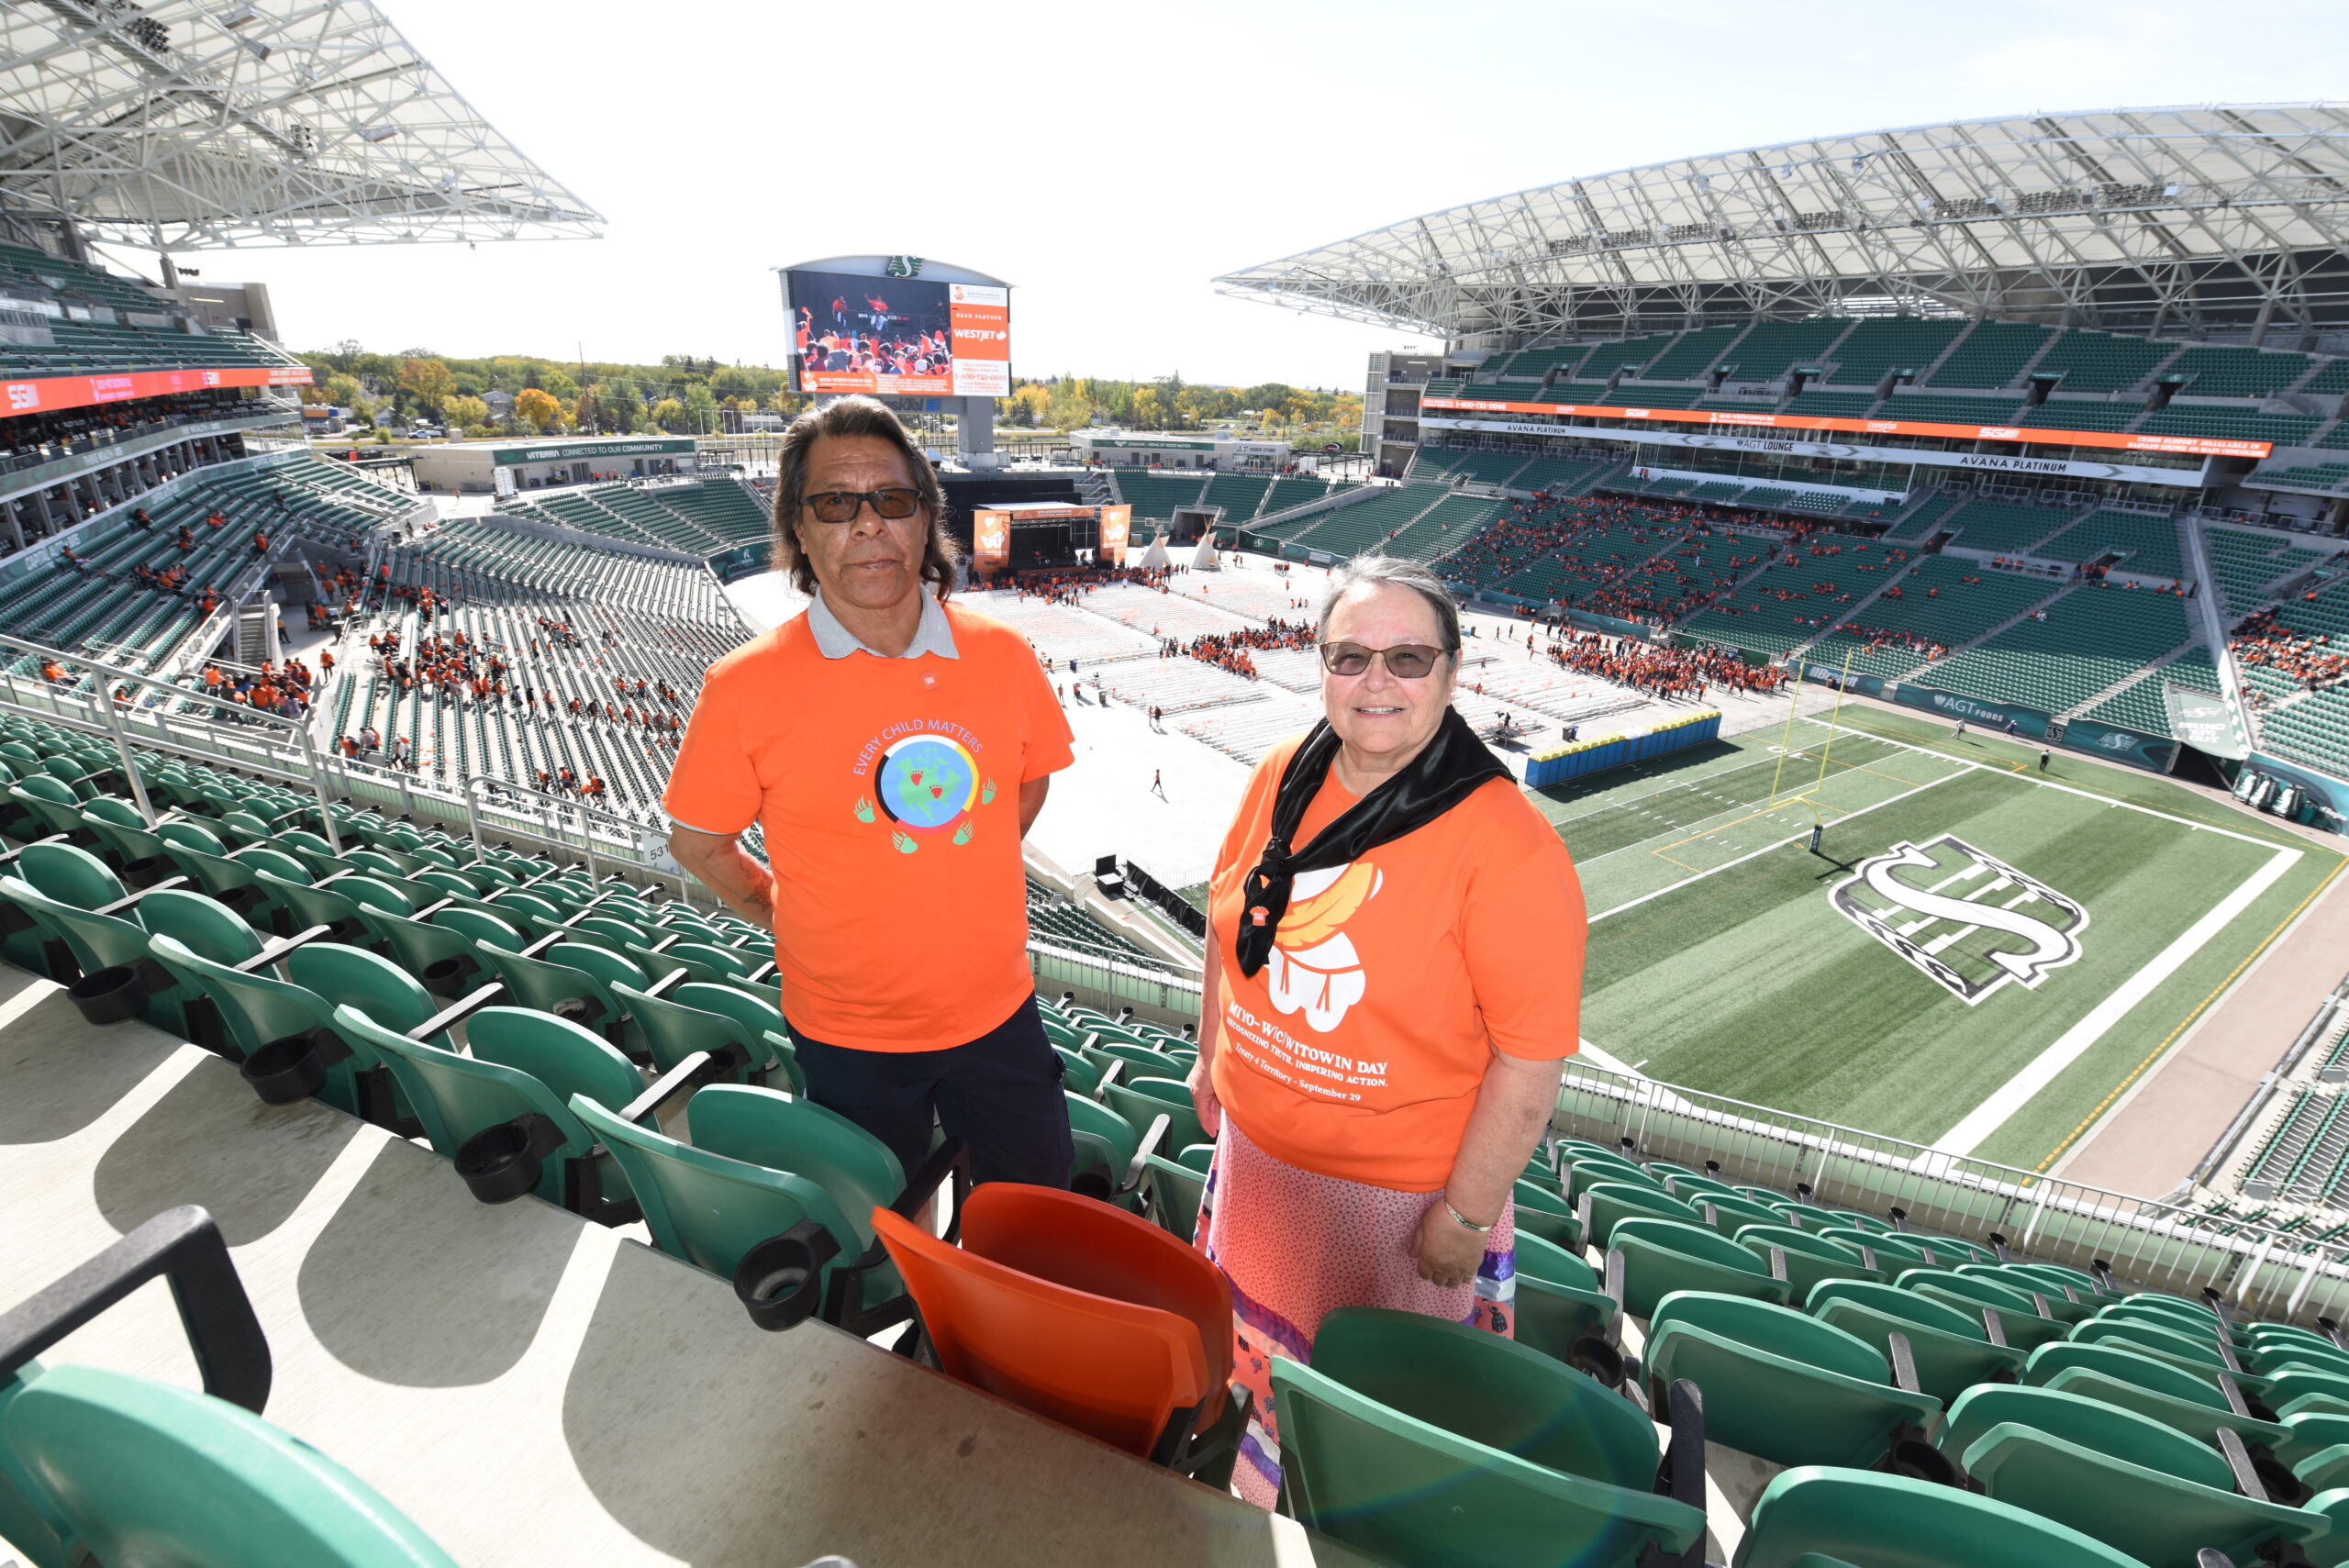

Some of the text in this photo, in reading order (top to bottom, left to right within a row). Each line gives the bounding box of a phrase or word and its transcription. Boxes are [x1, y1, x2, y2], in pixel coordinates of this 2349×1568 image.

[953, 328, 996, 342] WESTJET
[1455, 401, 1507, 411] 1-800-721-0066
[1743, 441, 1794, 452] AGT LOUNGE
[2127, 441, 2160, 450] HARVARD
[2199, 446, 2221, 454] MAIN
[2221, 448, 2266, 457] CONCOURSE
[2164, 438, 2198, 446] SUPPORT
[526, 443, 663, 460] VITERRA CONNECTED TO OUR COMMUNITY
[1960, 456, 2067, 473] AVANA PLATINUM
[1708, 641, 1740, 654] MOLSON
[1943, 696, 2003, 723] AGT FOODS
[852, 718, 984, 776] EVERY CHILD MATTERS
[650, 842, 669, 861] 531
[1226, 1016, 1388, 1087] RECOGNIZING TRUTH. INSPIRING ACTION.
[1235, 1042, 1255, 1062] Treaty
[1260, 1059, 1293, 1084] Territory
[1298, 1079, 1348, 1100] September
[1349, 1093, 1362, 1103] 29
[1356, 1061, 1388, 1075] DAY
